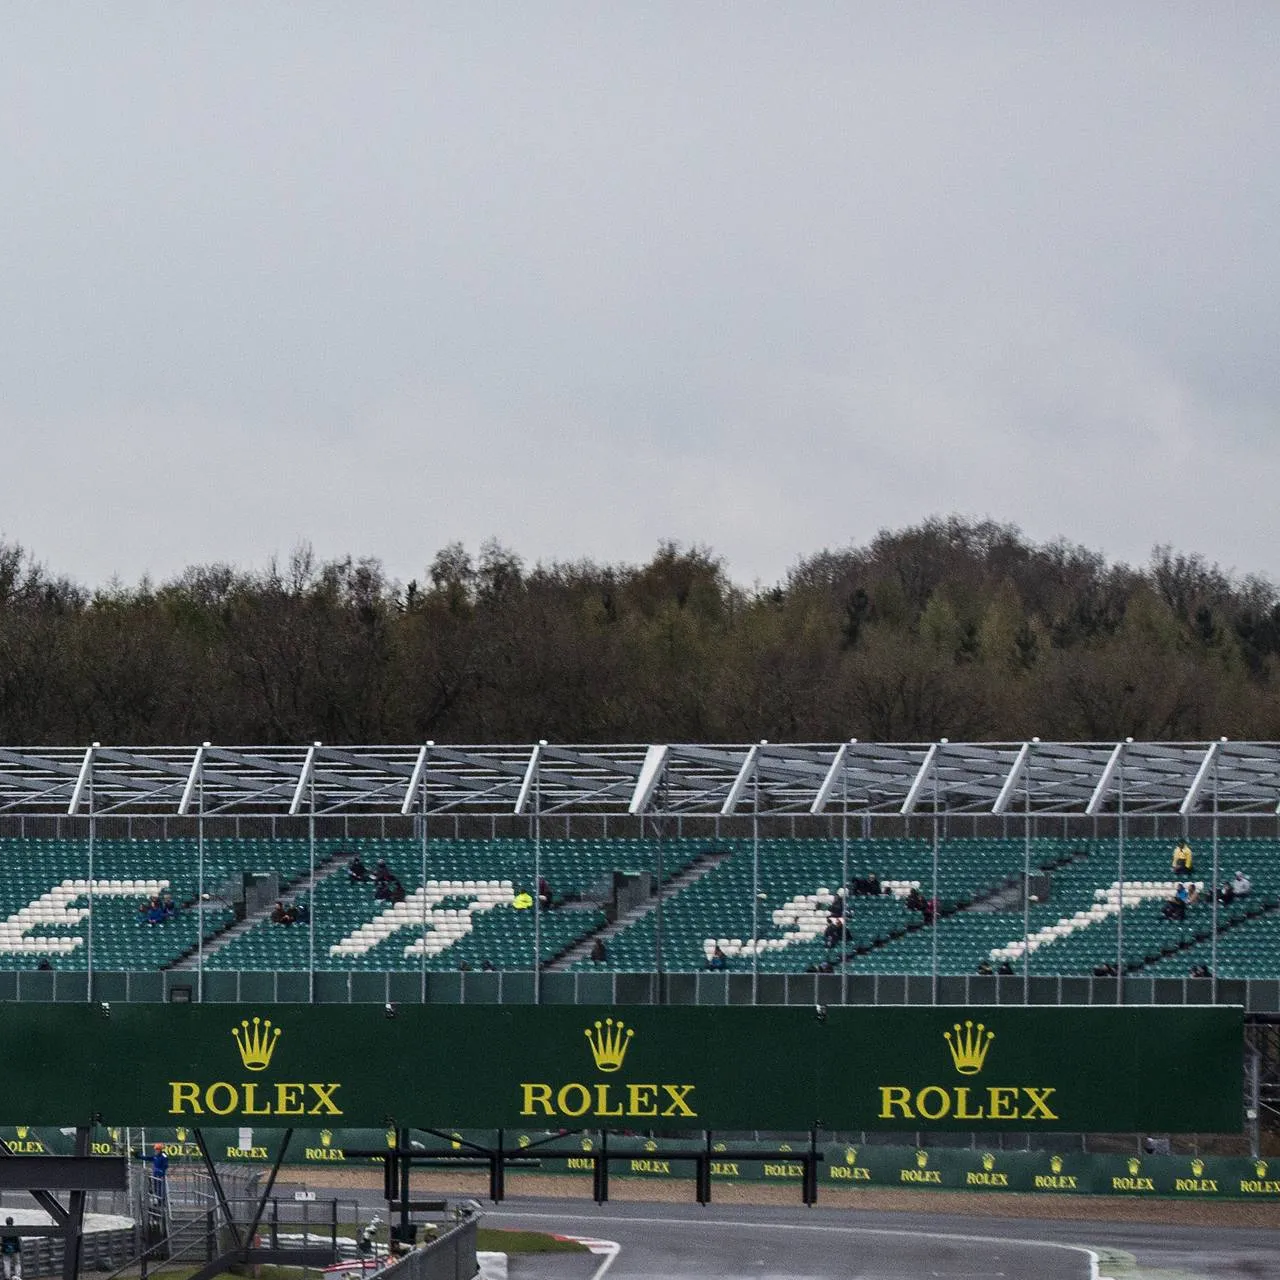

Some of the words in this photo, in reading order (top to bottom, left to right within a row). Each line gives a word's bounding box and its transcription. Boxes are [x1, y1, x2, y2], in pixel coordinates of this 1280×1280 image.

[168, 1083, 343, 1116] ROLEX
[520, 1083, 698, 1117] ROLEX
[878, 1087, 1059, 1121] ROLEX
[305, 1148, 346, 1161] ROLEX
[630, 1160, 670, 1174] ROLEX
[710, 1163, 739, 1176] OLEX
[764, 1164, 804, 1177] ROLEX
[830, 1166, 871, 1180] ROLEX
[900, 1169, 942, 1183] ROLEX
[967, 1172, 1008, 1186] ROLEX
[1034, 1175, 1077, 1189] ROLEX
[1112, 1177, 1154, 1190] ROLEX
[1175, 1178, 1218, 1192] ROLEX
[1240, 1180, 1280, 1193] ROLEX
